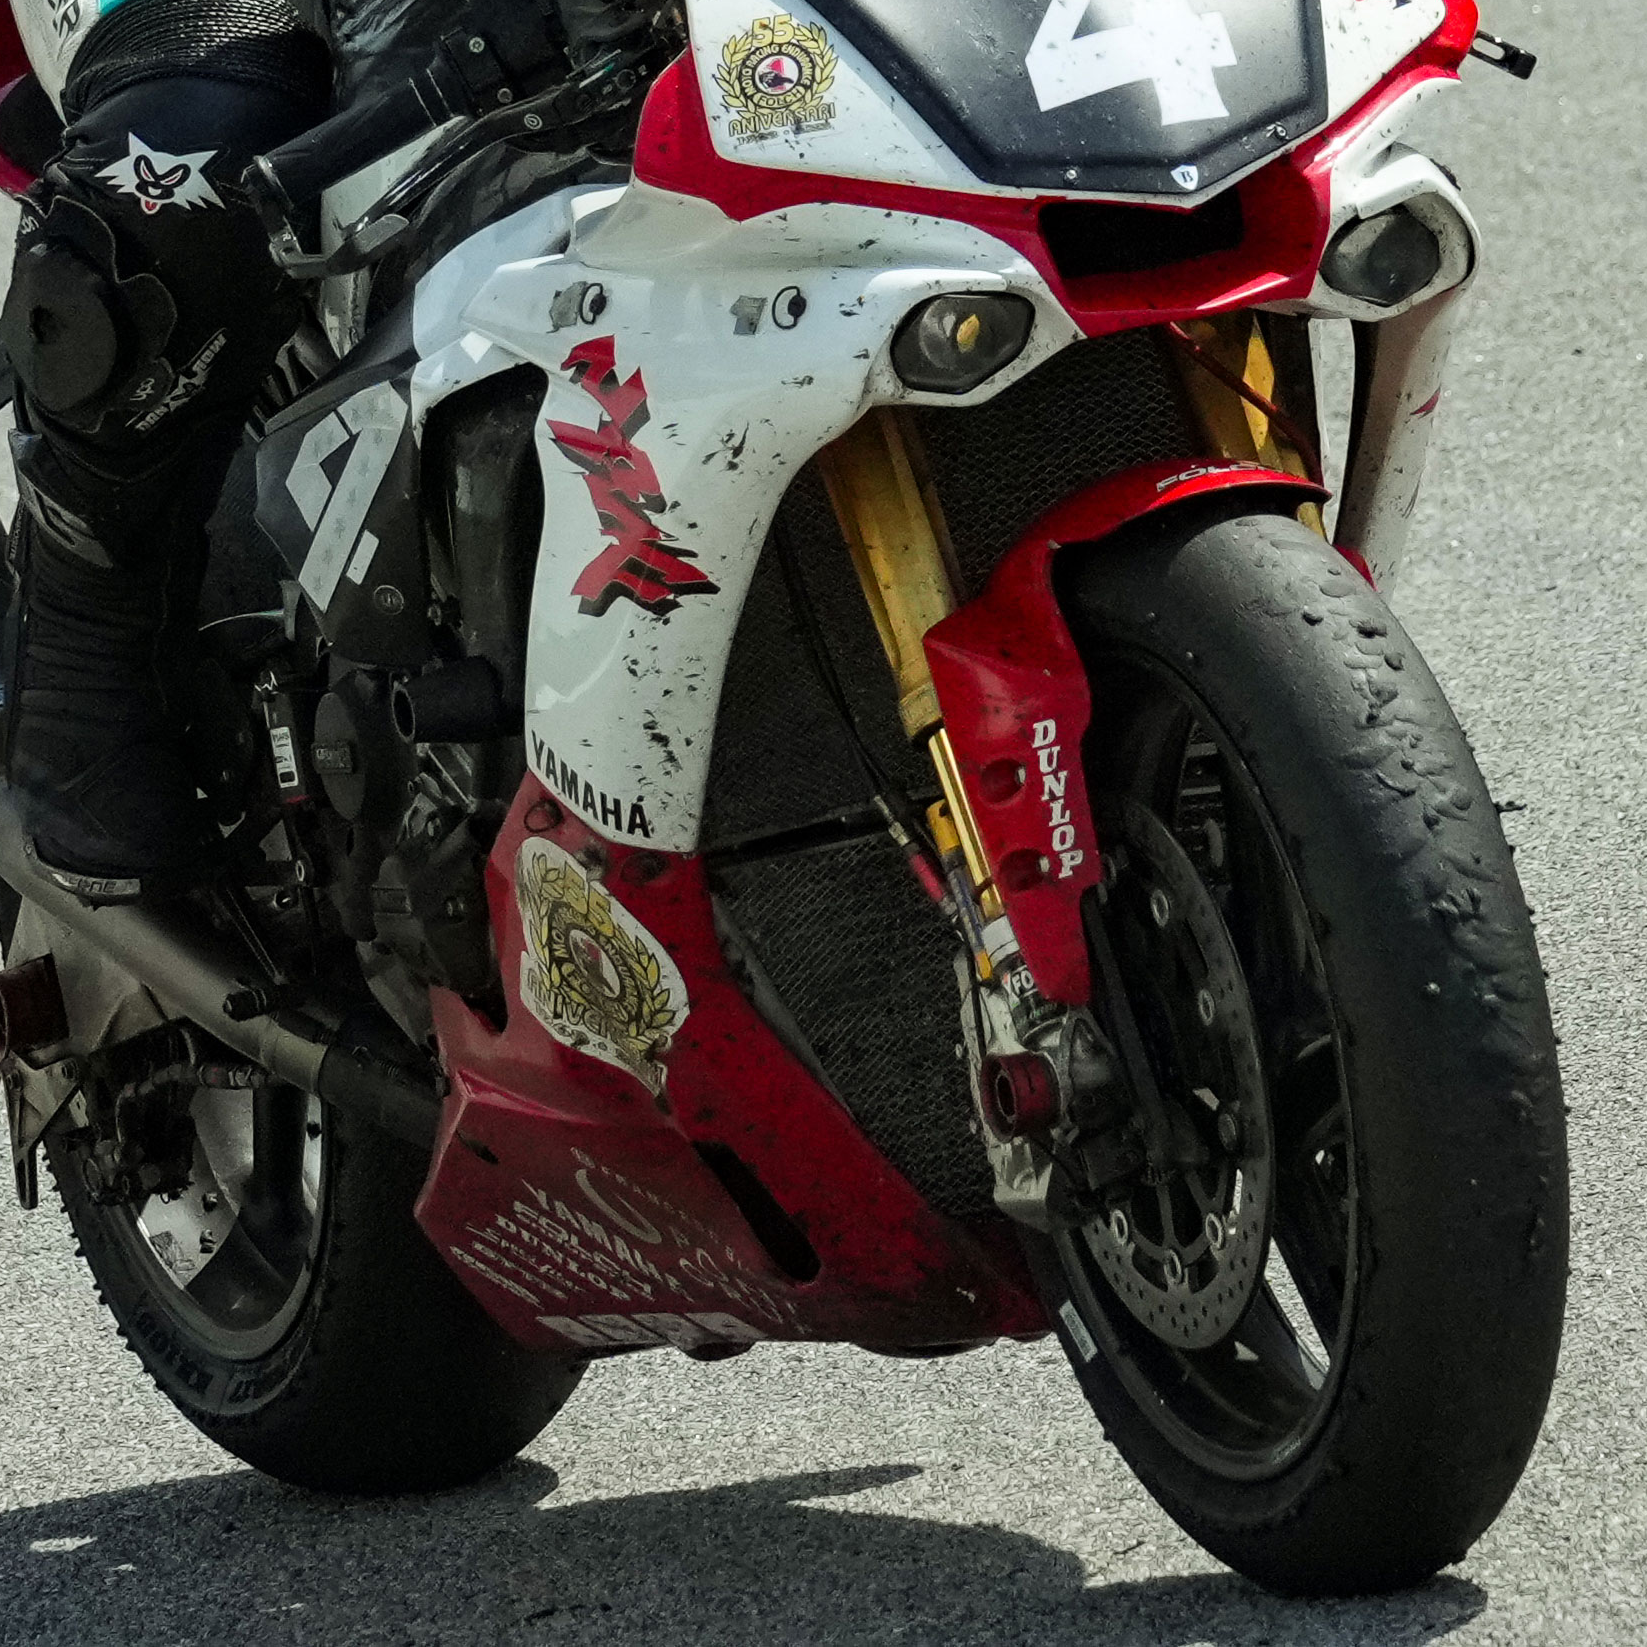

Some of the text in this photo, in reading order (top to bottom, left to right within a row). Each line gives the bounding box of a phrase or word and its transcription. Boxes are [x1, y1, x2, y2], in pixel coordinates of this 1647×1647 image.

[751, 12, 795, 48] 55
[757, 87, 804, 107] FOLCH
[728, 102, 836, 138] ANIVERSARI
[530, 728, 652, 839] YAMAHA
[1030, 718, 1084, 879] DUNLOP
